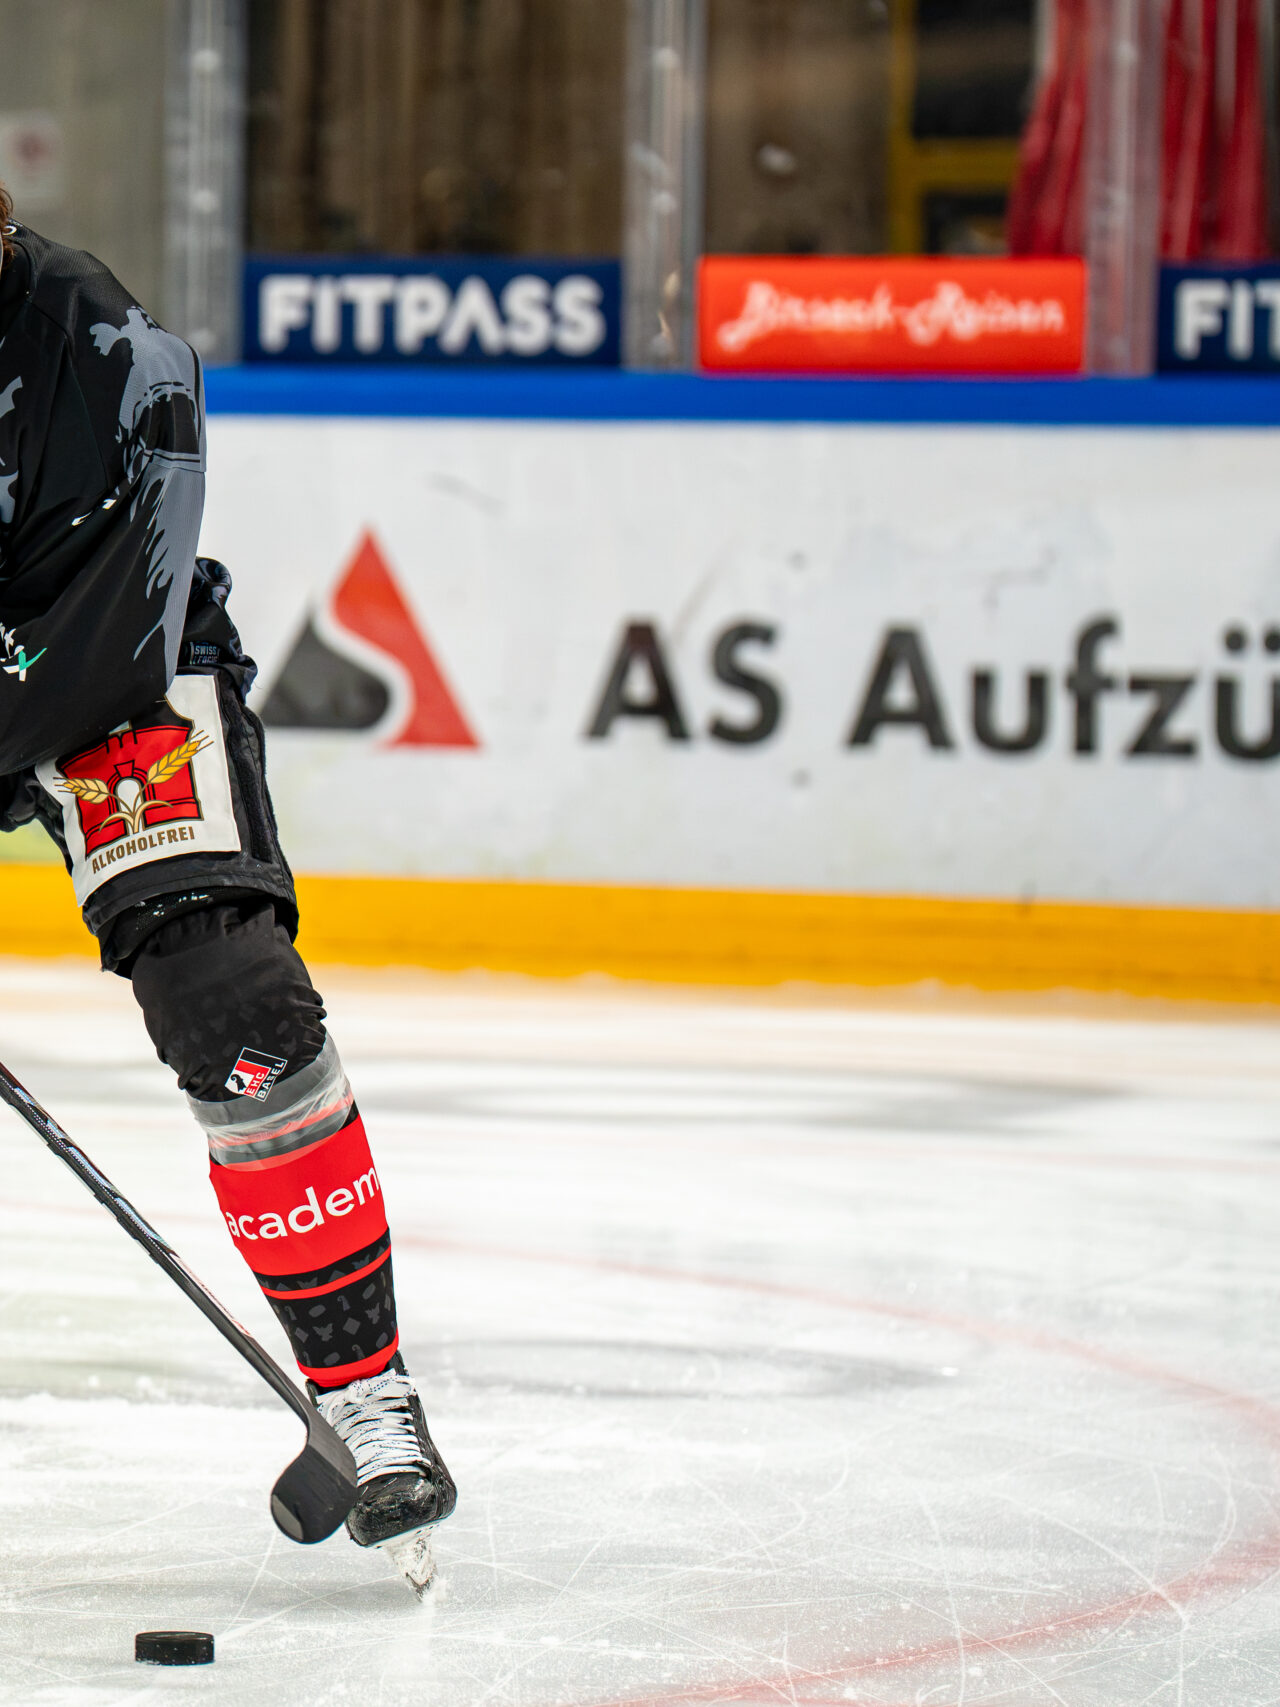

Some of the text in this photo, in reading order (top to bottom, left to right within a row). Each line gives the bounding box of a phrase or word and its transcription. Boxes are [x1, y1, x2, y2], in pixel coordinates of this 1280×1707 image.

[258, 273, 607, 356] FITPASS
[584, 609, 1280, 763] AS Aufzü
[91, 826, 195, 875] ALKOHOLFREI
[246, 1072, 265, 1095] EHC
[257, 1062, 285, 1099] BASEL
